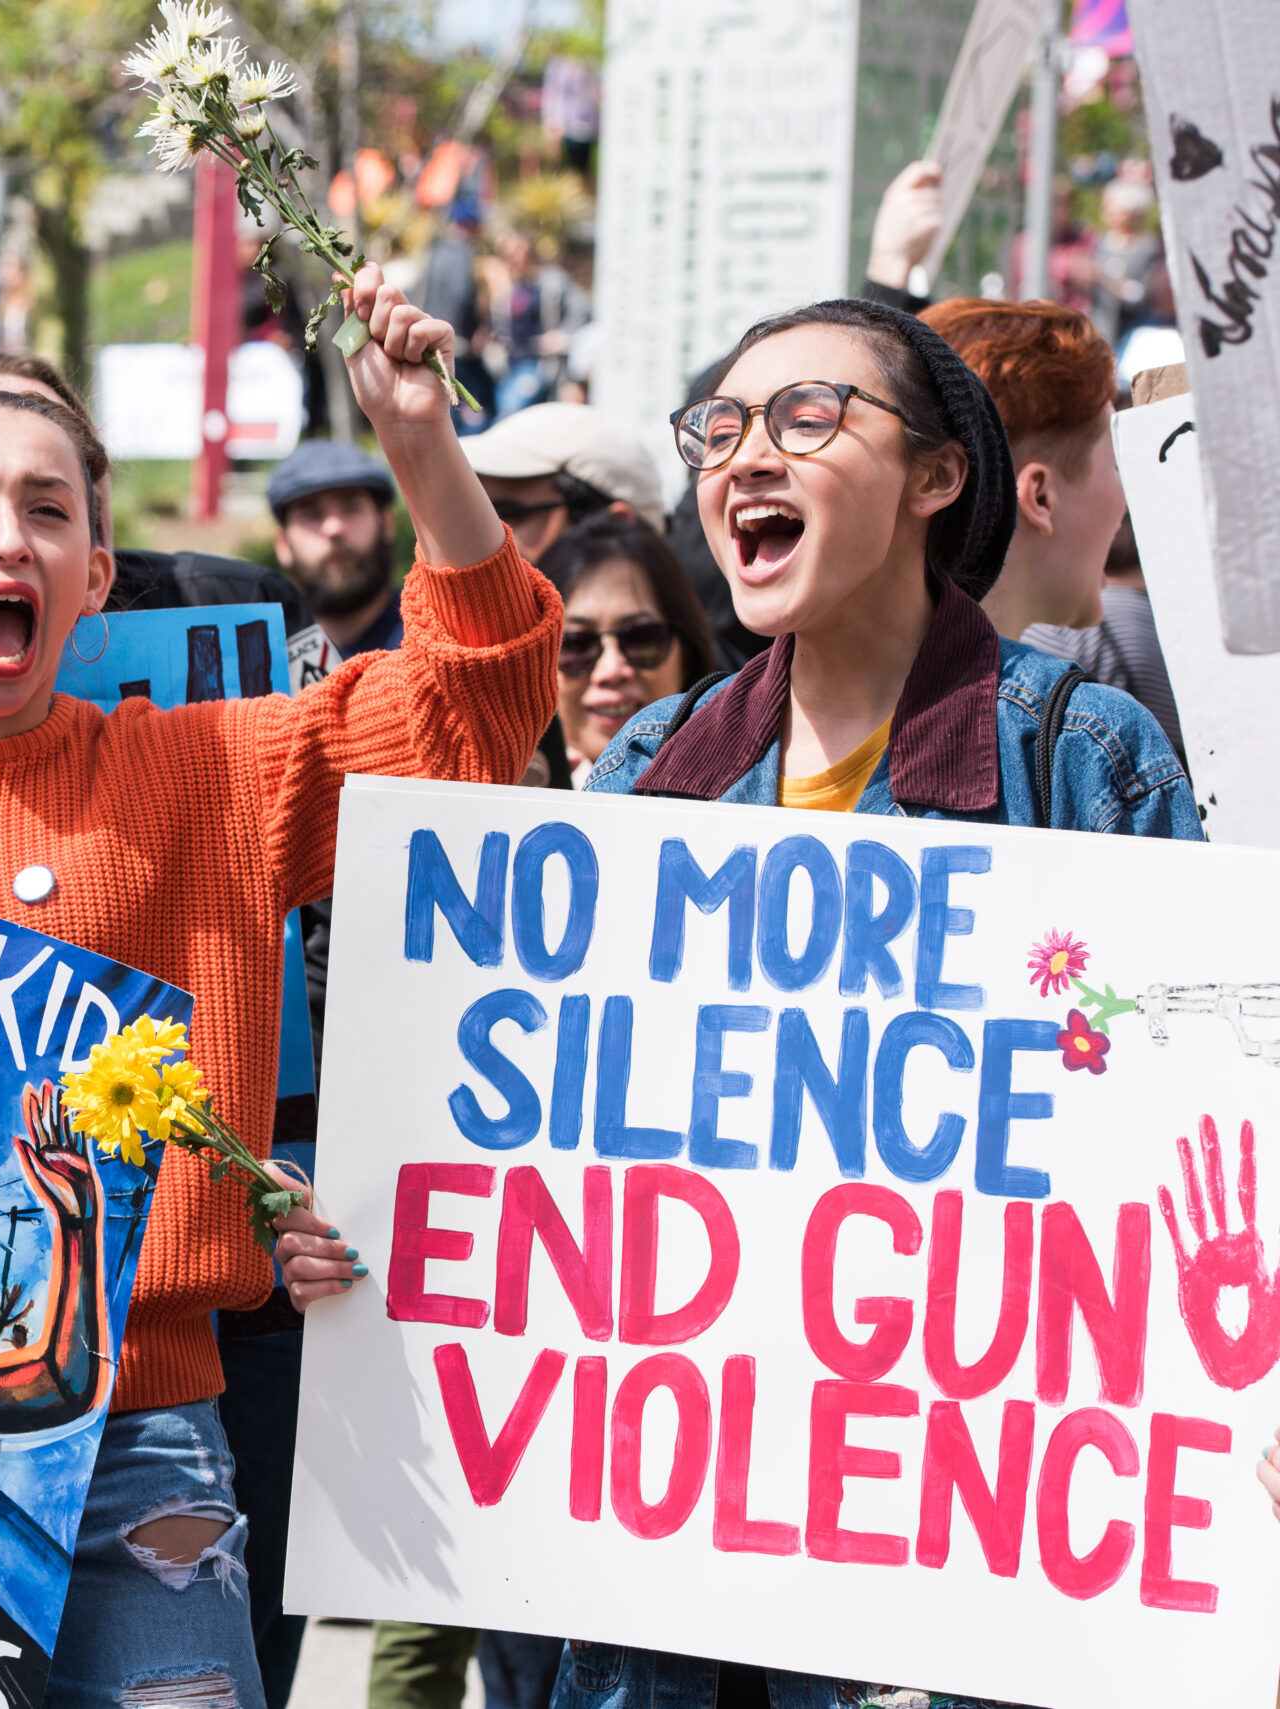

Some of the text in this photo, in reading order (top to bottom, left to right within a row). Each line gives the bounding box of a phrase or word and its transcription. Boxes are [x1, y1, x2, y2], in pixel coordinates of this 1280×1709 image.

[405, 821, 993, 1010] NO MORE
[448, 988, 1062, 1198] SILENCE
[386, 1162, 1150, 1407] END GUN
[433, 1342, 1233, 1613] VIOLENCE
